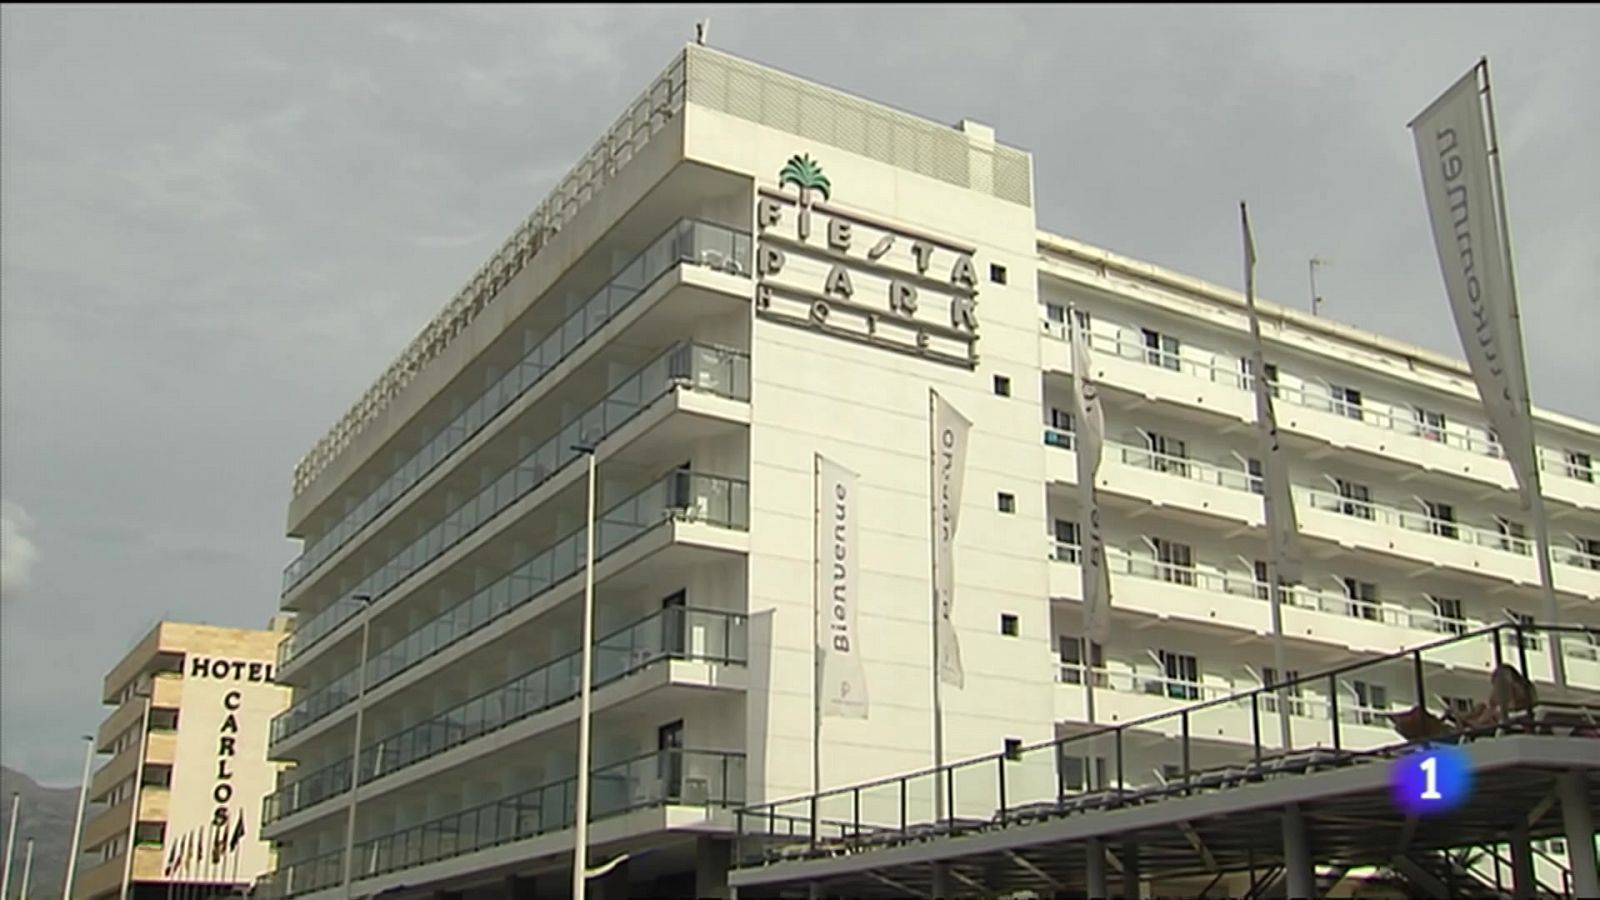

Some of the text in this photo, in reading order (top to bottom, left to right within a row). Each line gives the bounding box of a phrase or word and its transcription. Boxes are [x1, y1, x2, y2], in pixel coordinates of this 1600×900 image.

[757, 243, 979, 332] PARK
[831, 483, 850, 653] Bienvenue
[191, 658, 275, 682] HOTEL
[213, 692, 242, 827] CARLOS
